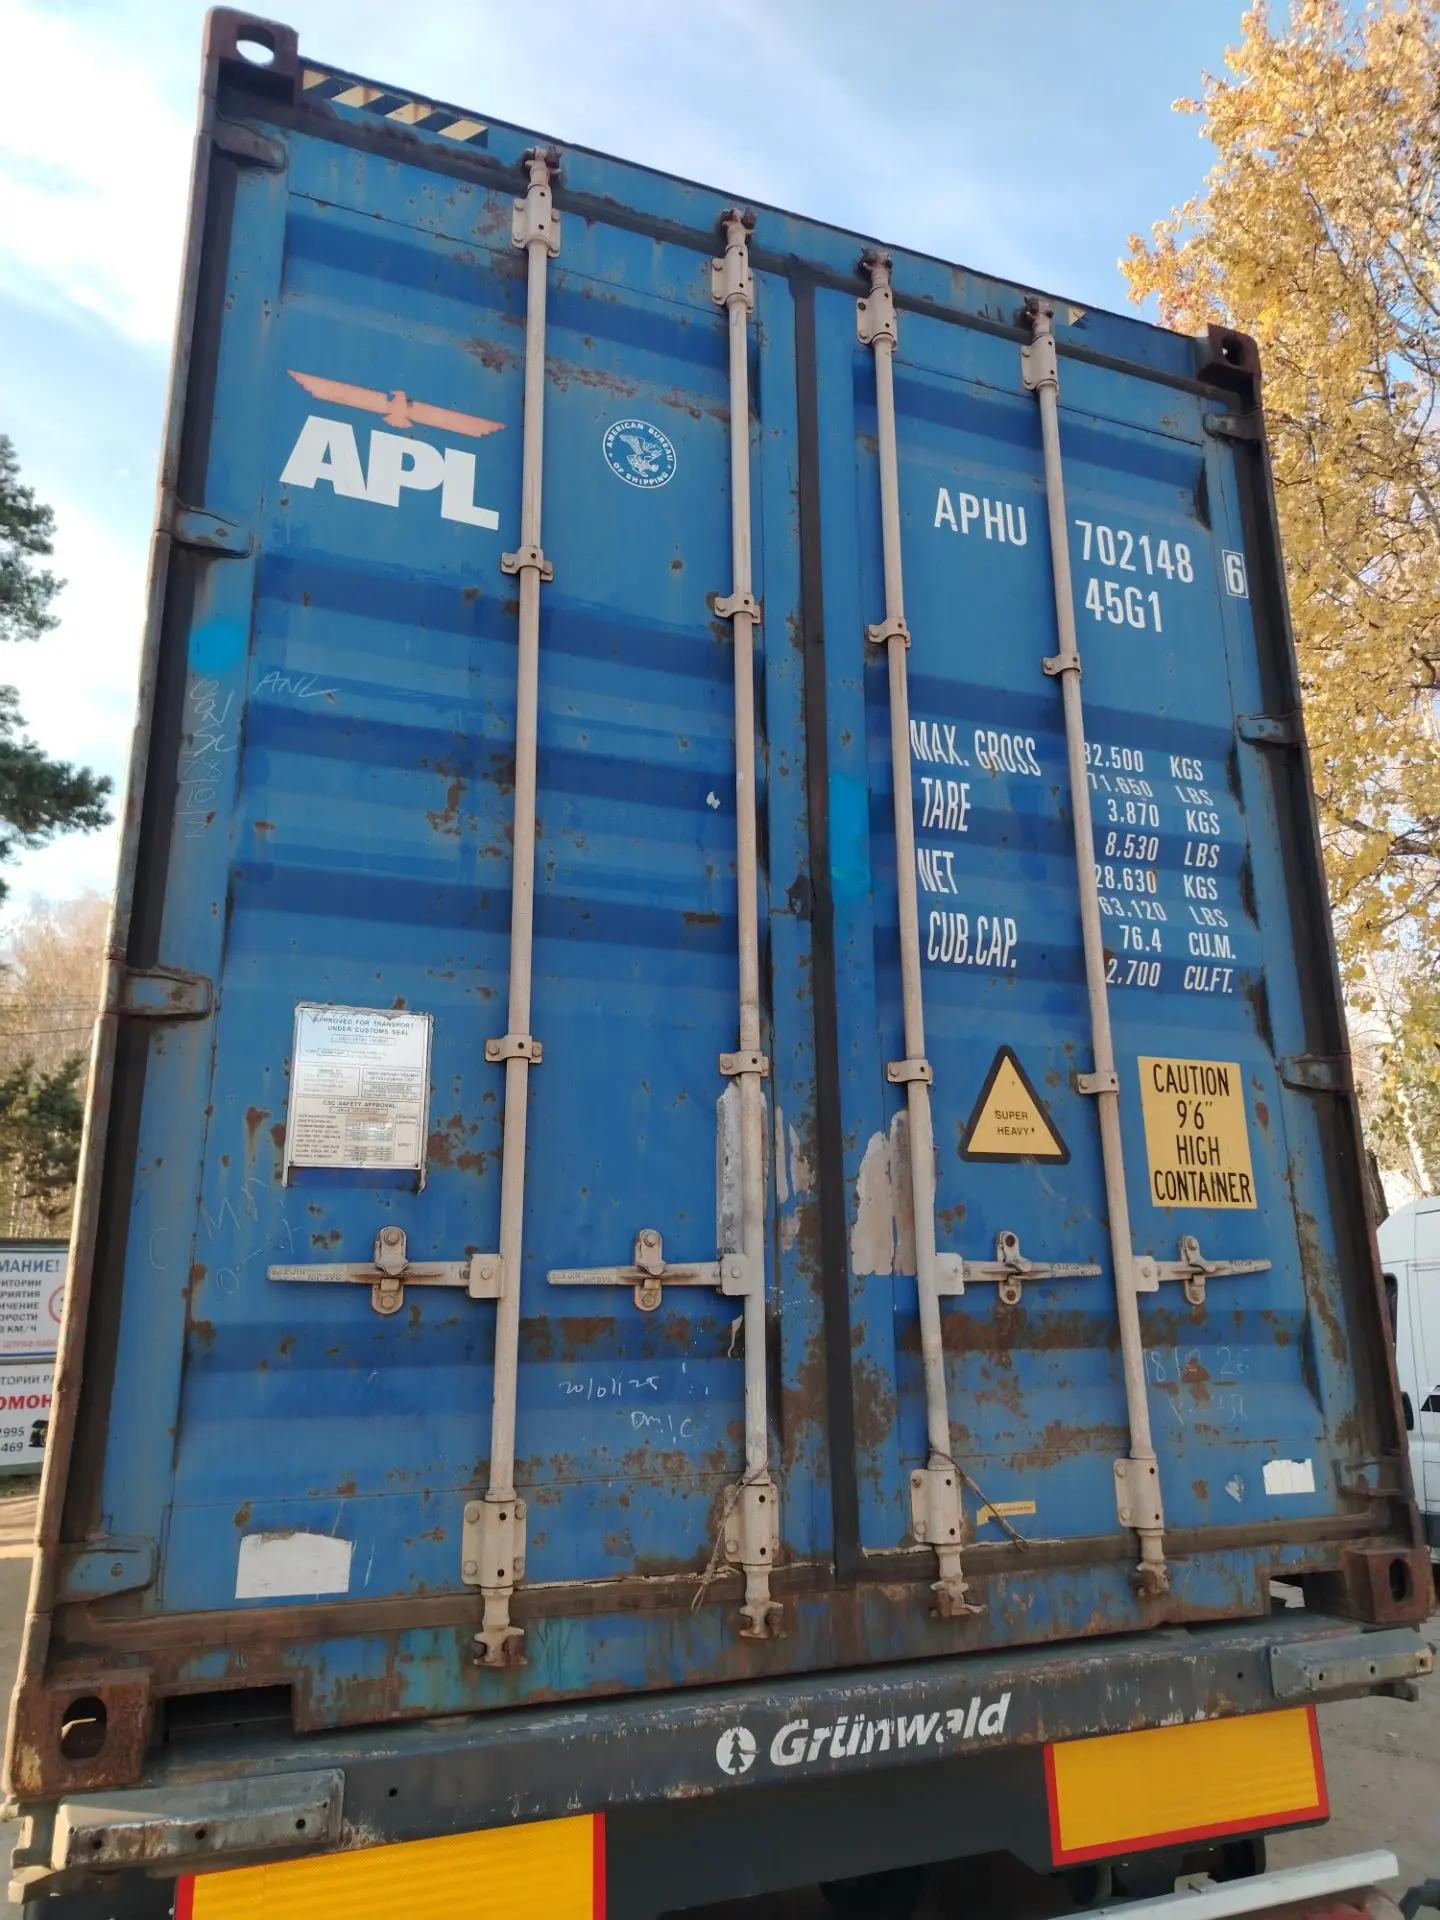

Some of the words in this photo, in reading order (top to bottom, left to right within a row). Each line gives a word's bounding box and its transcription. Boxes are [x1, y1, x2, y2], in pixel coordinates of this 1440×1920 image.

[606, 422, 644, 448] AMERICAN
[648, 427, 674, 461] BUREAU
[278, 415, 499, 530] APL
[613, 462, 625, 473] OF
[625, 472, 669, 486] SHIPPING
[934, 487, 1028, 547] APHU
[1074, 519, 1194, 584] 702148
[1225, 553, 1246, 595] 6
[1085, 577, 1162, 633] 45G1
[909, 719, 970, 767] MAX.
[974, 729, 1042, 776] GROSS
[1169, 755, 1204, 782] KGS
[920, 777, 972, 832] TARE
[1174, 784, 1214, 807] LBS
[1107, 798, 1160, 827] 3.870
[1186, 809, 1221, 836] KGS
[917, 848, 959, 894] NET
[1184, 841, 1220, 869] LBS
[1183, 874, 1218, 901] KGS
[1188, 905, 1229, 928] LBS
[927, 911, 1018, 969] CUB.CAP.
[1118, 924, 1162, 952] 76.4
[1188, 932, 1237, 960] CU.M.
[1183, 965, 1234, 993] CU.FT.
[354, 1026, 389, 1035] CUSTOMS
[373, 1020, 415, 1029] TRANSPORT
[1153, 1063, 1230, 1097] CAUTION
[994, 1110, 1028, 1121] SUPER
[997, 1126, 1030, 1137] HEAVY
[1175, 1134, 1221, 1167] HIGH
[1153, 1170, 1253, 1204] CONTAINER
[769, 1692, 1012, 1767] Grünwald
